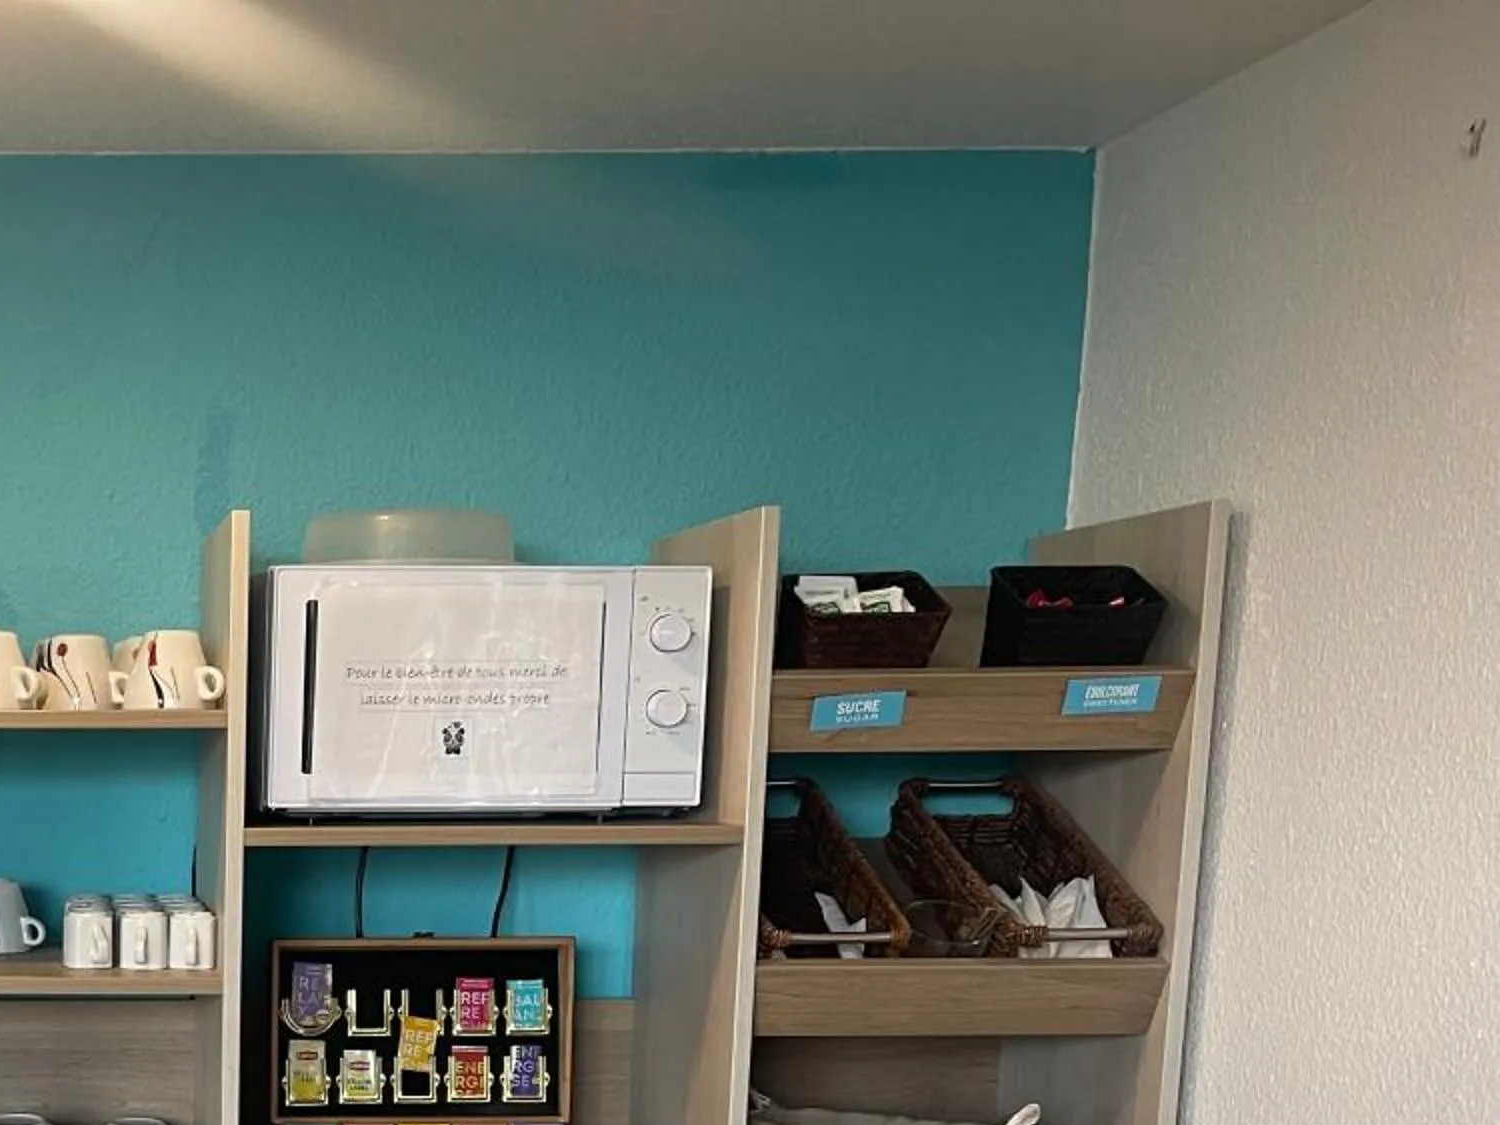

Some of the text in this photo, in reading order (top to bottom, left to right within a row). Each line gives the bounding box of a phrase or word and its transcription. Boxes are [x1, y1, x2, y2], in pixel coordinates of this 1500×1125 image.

[347, 667, 376, 679] Pour
[381, 666, 392, 679] le
[458, 666, 473, 678] de
[551, 665, 567, 677] de
[837, 699, 882, 715] SUCRE
[461, 991, 489, 1005] REF
[461, 1007, 481, 1019] RE
